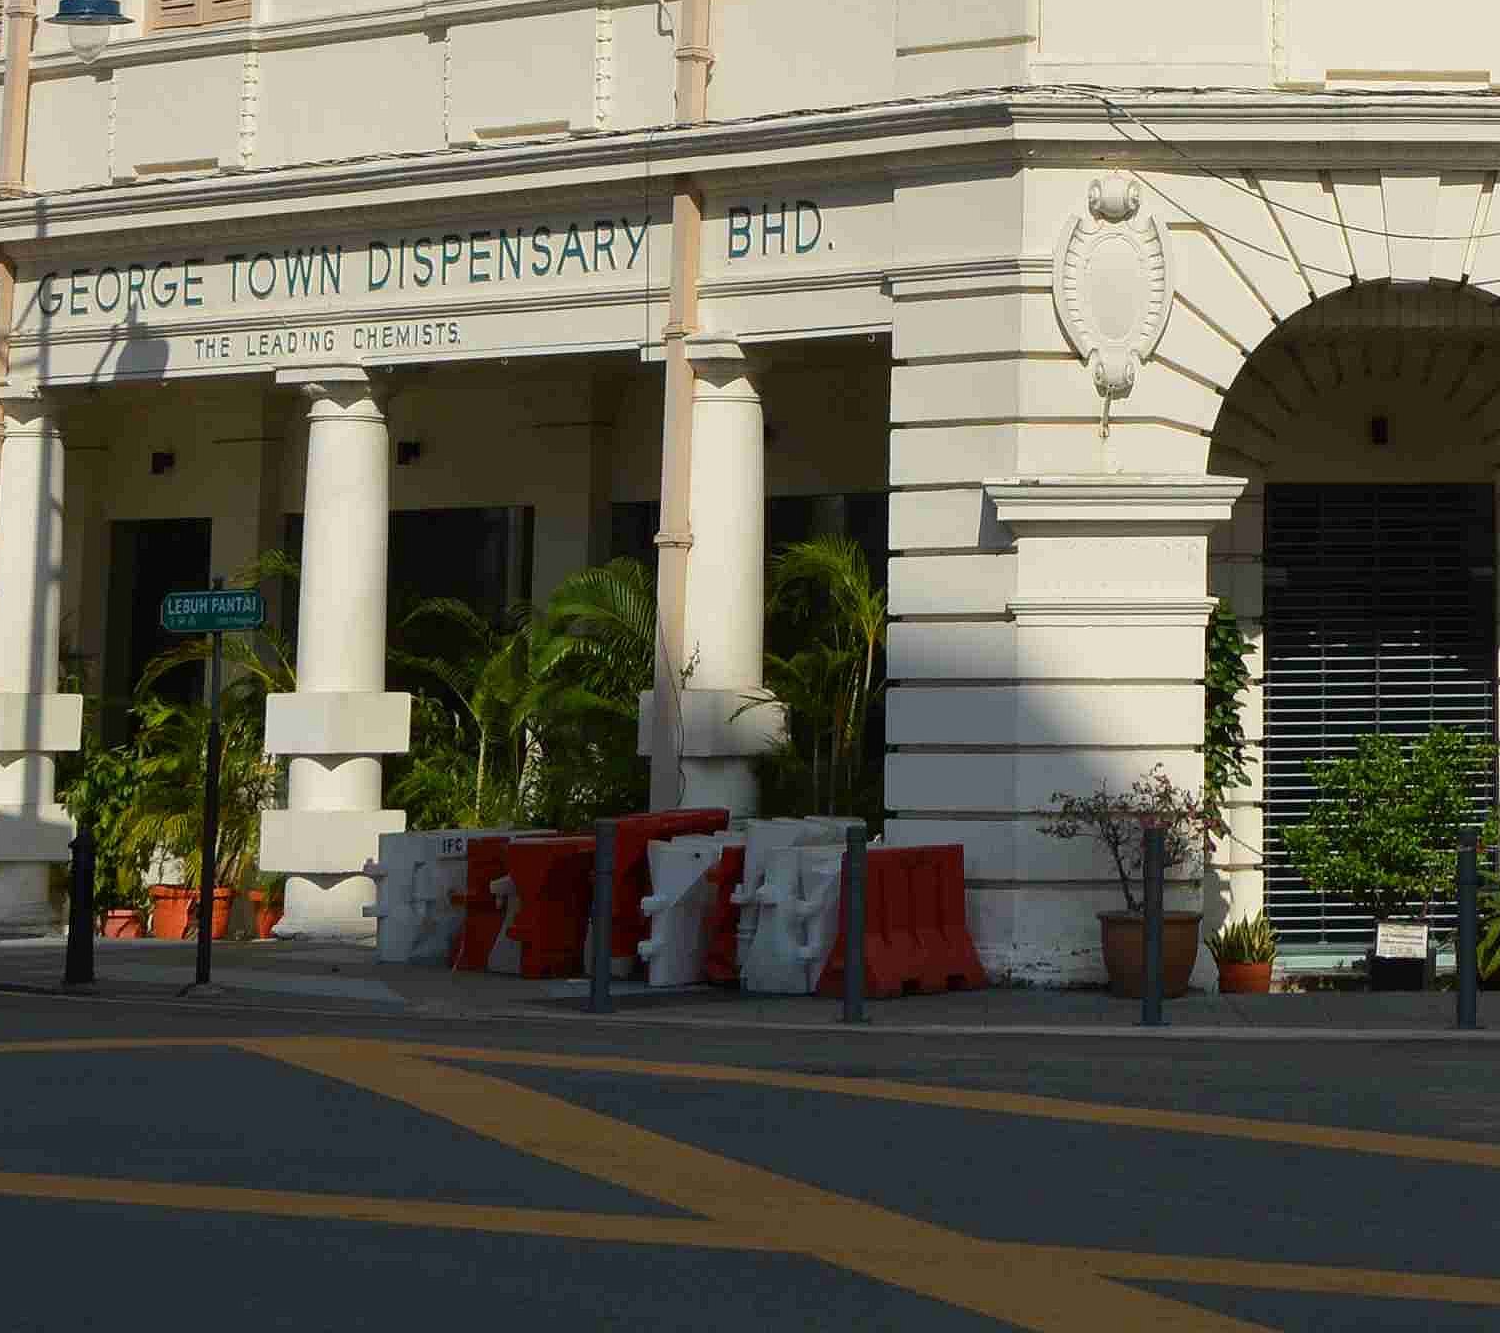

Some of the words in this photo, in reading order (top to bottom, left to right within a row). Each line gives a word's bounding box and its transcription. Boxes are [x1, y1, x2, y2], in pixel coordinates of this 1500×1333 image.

[38, 257, 205, 317] GEORGE
[226, 245, 343, 303] TOWN
[367, 215, 653, 292] DISPENSARY
[728, 200, 835, 259] BHD.
[195, 336, 230, 359] THE
[246, 329, 335, 357] LEADING
[168, 596, 208, 614] LEBUH
[211, 596, 257, 614] PANTAI
